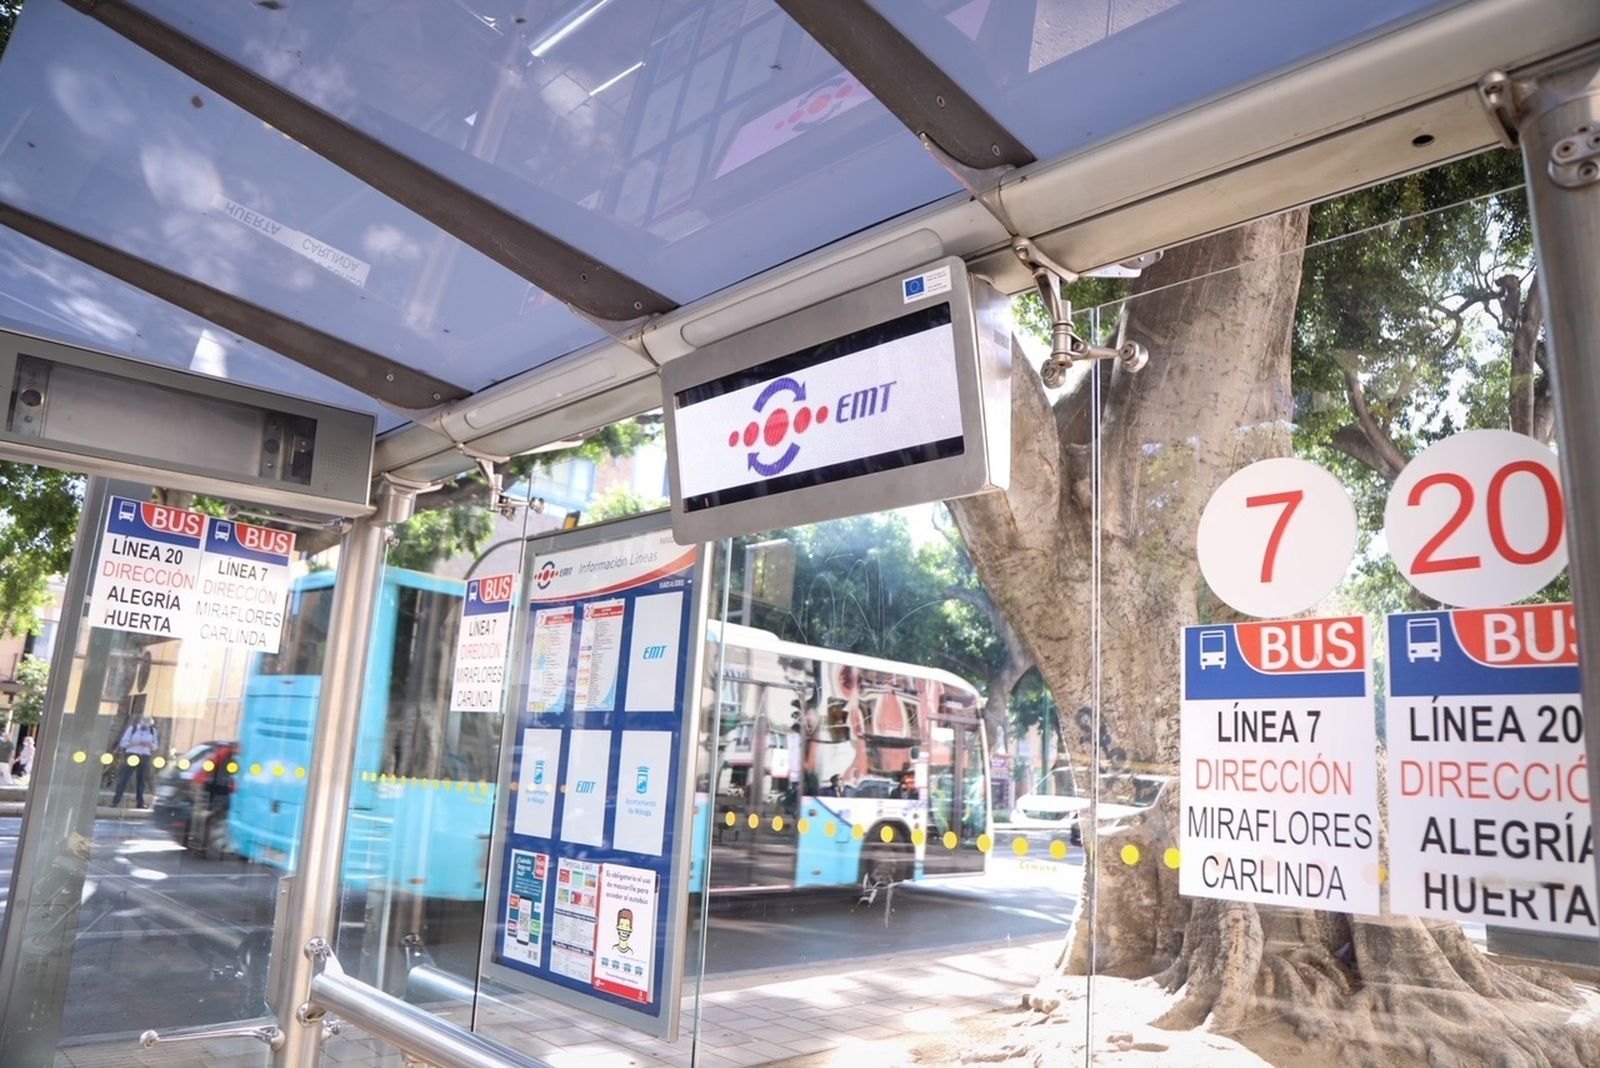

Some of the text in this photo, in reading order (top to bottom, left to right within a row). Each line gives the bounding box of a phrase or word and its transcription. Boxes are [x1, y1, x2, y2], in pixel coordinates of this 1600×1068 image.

[836, 381, 897, 424] EMT
[153, 507, 199, 535] BUS
[1407, 460, 1564, 575] 20
[112, 535, 184, 565] LÍNEA 20
[245, 527, 289, 553] BUS
[1246, 490, 1304, 583] 7
[102, 560, 195, 590] DIRECCIÓN
[218, 558, 268, 582] LÍNEA 7
[107, 586, 181, 611] ALEGRÍA
[203, 579, 277, 605] DIRECCIÓN
[484, 576, 510, 600] BUS
[104, 609, 171, 633] HUERTA
[196, 601, 282, 628] MIRAFLORES
[492, 619, 497, 635] 7
[200, 624, 268, 648] CARLINDA
[1261, 621, 1356, 670] BUS
[1483, 609, 1578, 662] BU
[643, 645, 668, 659] EMT
[1218, 702, 1321, 743] LÍNEA 7
[1409, 696, 1584, 743] LÍNEA 20
[575, 780, 596, 794] EMT
[1195, 753, 1352, 795] DIRECCIÓN
[1401, 754, 1590, 803] DIRECCIÓ
[1188, 806, 1373, 849] MIRAFLORES
[1202, 855, 1347, 900] CARLINDA
[1424, 871, 1597, 927] HUERTA
